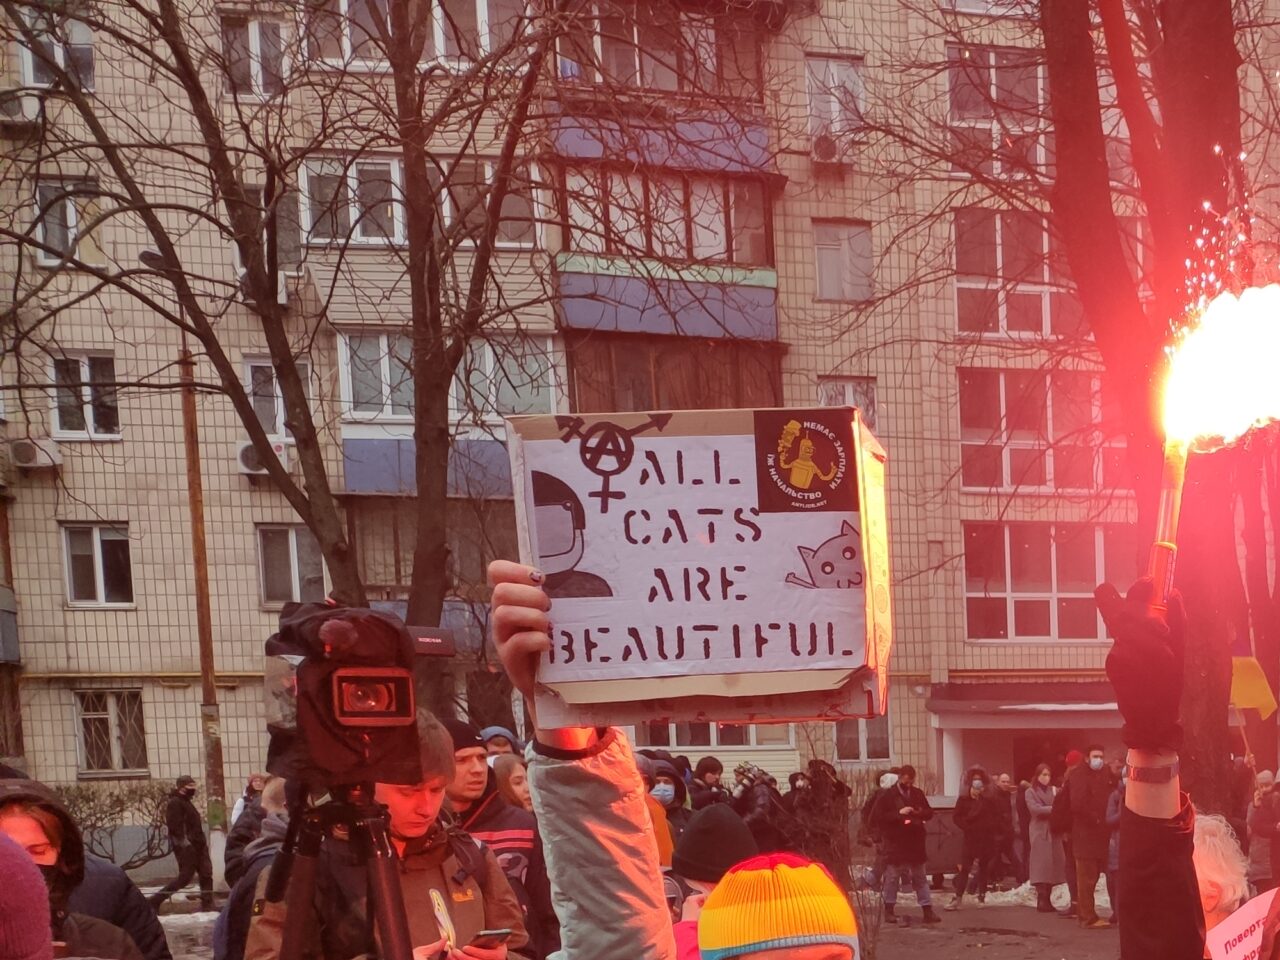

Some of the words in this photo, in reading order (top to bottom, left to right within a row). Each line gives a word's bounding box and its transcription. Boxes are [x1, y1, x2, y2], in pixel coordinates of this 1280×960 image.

[640, 450, 740, 485] ALL
[829, 440, 846, 490] ЗАРПЛАТИ
[769, 468, 822, 500] НАЧАЛЬСТВО
[624, 507, 762, 544] CATS
[648, 566, 747, 602] ARE
[548, 622, 853, 664] BEAUTIFUL
